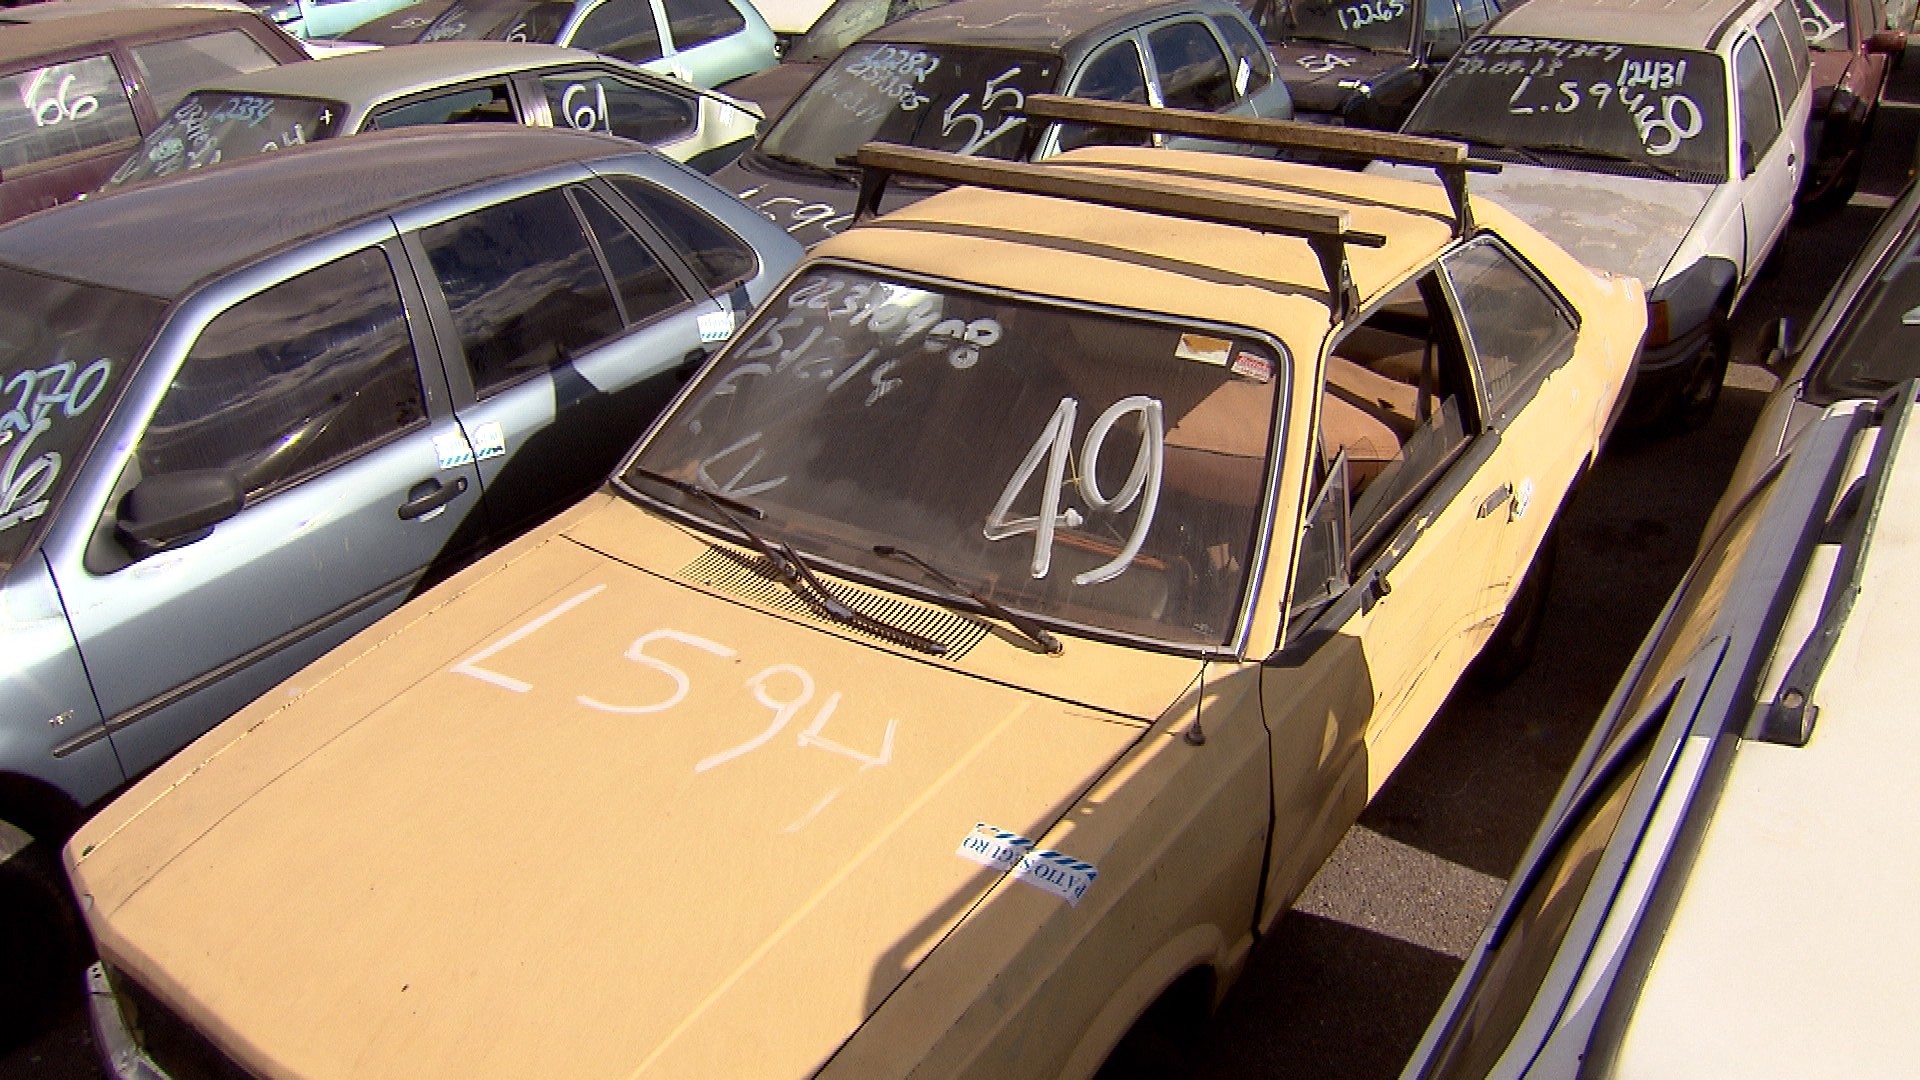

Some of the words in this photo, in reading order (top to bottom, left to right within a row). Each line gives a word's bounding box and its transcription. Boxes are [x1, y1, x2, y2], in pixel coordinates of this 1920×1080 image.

[23, 67, 99, 127] 66
[1616, 59, 1687, 91] 12431
[562, 83, 612, 136] 61
